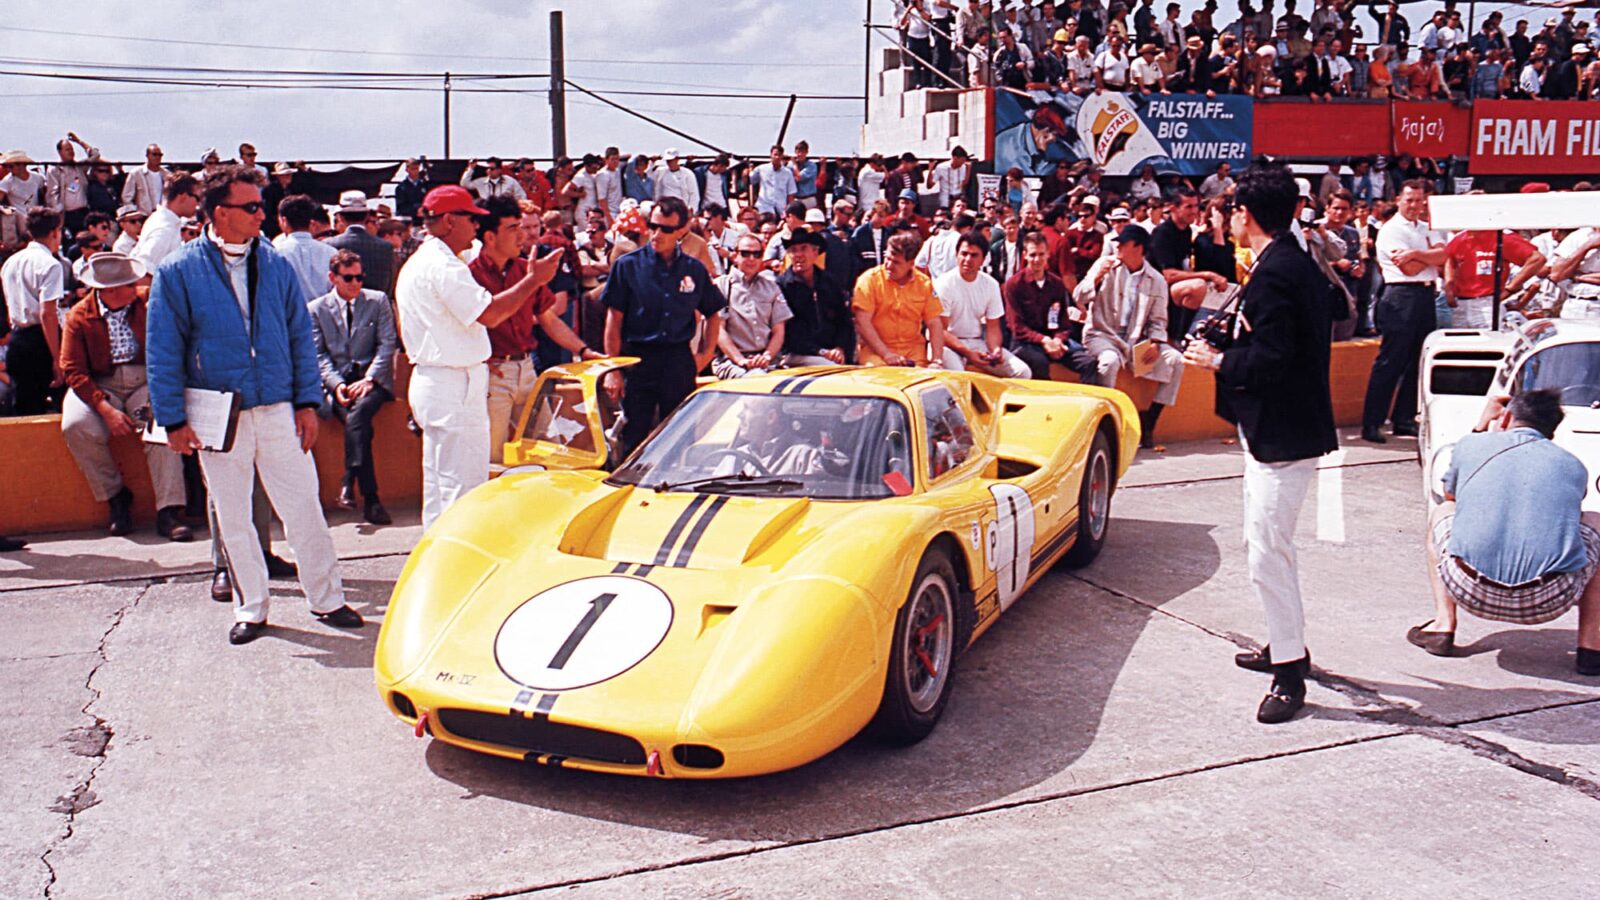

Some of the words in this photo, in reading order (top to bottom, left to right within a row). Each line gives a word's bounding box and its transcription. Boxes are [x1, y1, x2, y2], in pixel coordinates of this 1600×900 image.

[1147, 101, 1234, 119] FALSTAFF...
[1097, 112, 1130, 159] FALSTAFF
[1157, 122, 1189, 139] BIG
[1476, 118, 1557, 156] FRAM
[1565, 118, 1600, 156] FIL
[1170, 142, 1247, 160] WINNER!
[546, 592, 618, 670] 1
